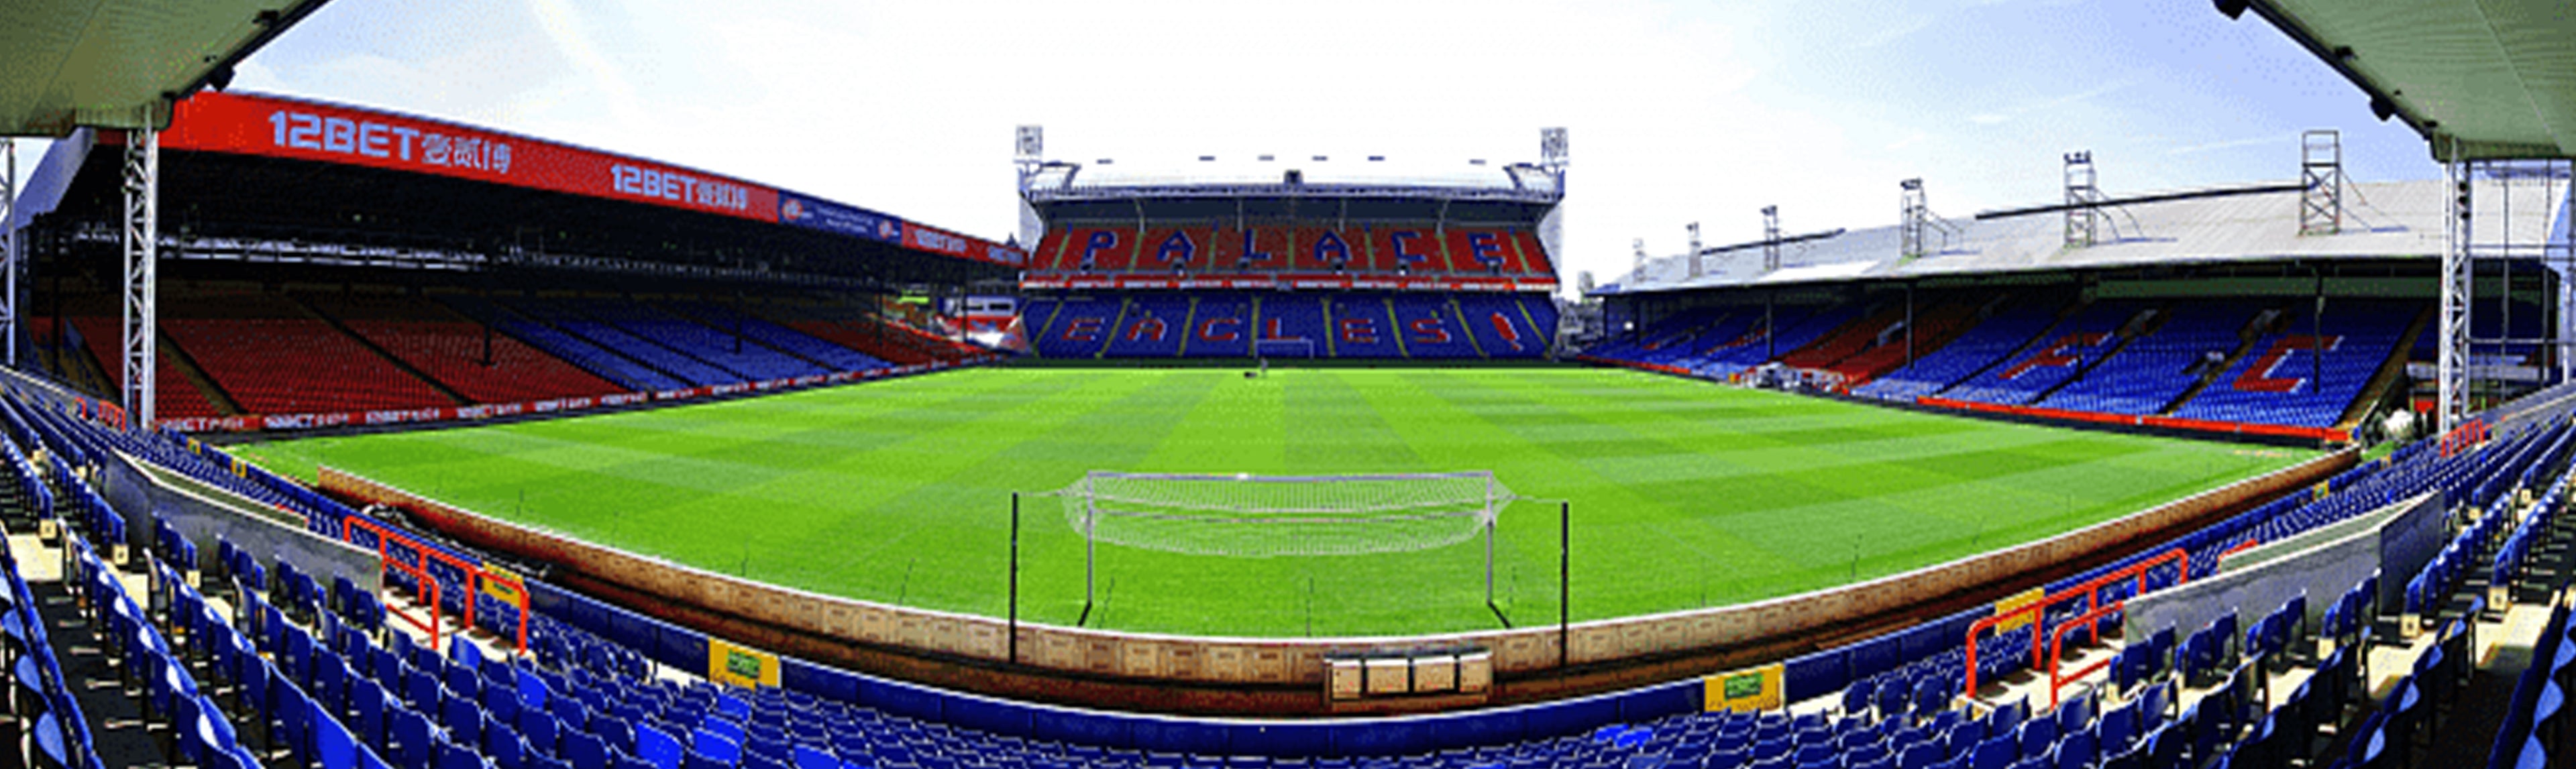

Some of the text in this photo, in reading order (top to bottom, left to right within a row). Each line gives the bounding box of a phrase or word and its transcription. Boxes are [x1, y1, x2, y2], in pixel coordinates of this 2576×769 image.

[269, 111, 420, 160] 12BET
[611, 164, 697, 203] 12BET
[1081, 229, 1505, 263] PALACE
